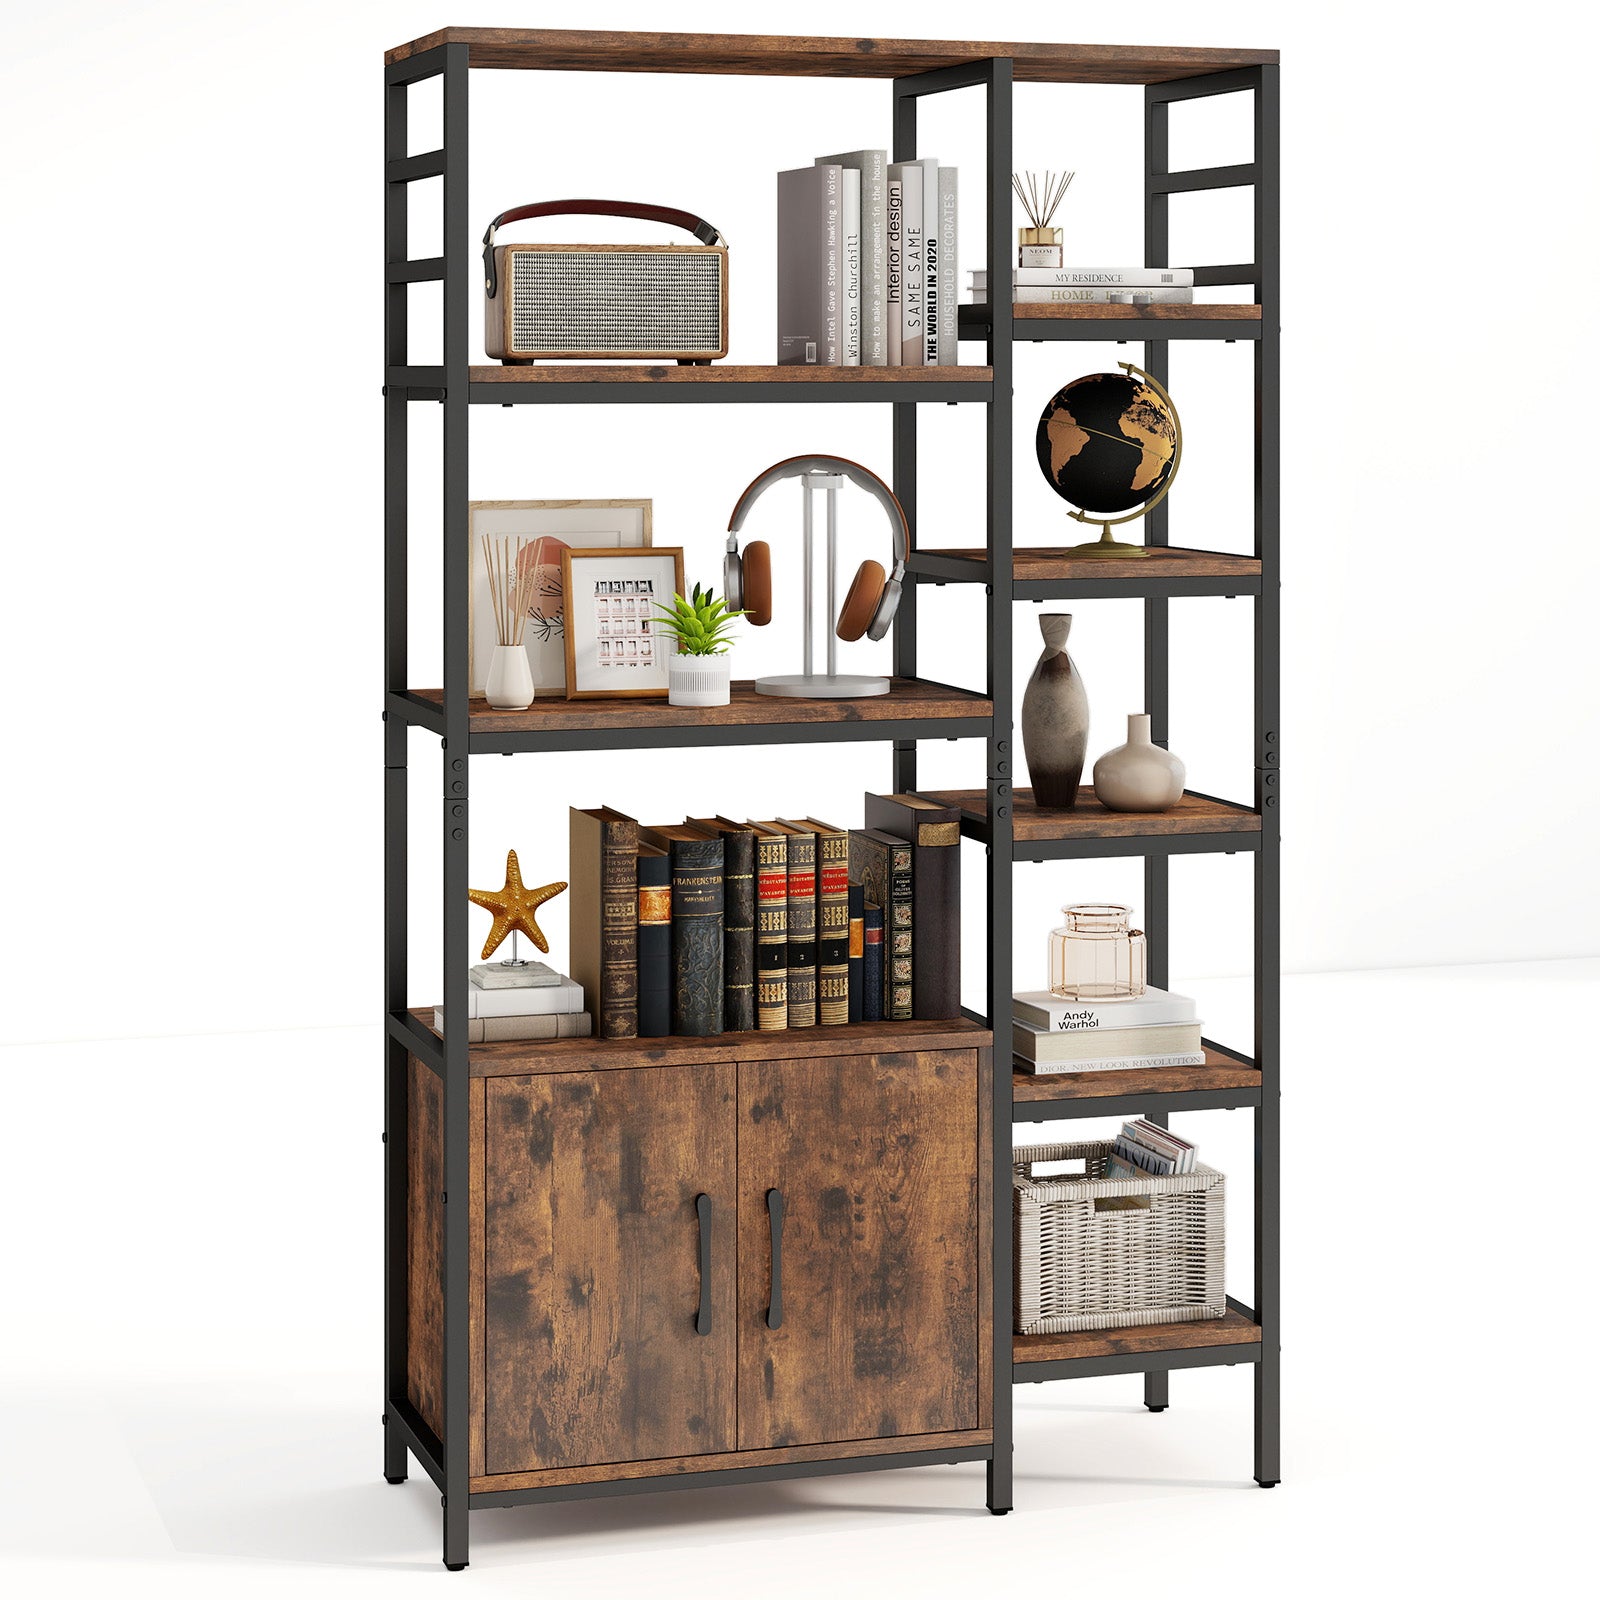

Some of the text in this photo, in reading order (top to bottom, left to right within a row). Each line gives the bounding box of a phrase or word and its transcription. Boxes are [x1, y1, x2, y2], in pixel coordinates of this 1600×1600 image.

[828, 169, 836, 195] Voice
[828, 210, 838, 246] Hawking
[872, 154, 883, 358] How to make an arrangement in the house
[887, 187, 902, 304] Interior design
[828, 250, 838, 286] Stephen
[908, 227, 921, 327] SAME SAME
[944, 193, 955, 336] HOUSEHOLD DECORATES
[1055, 273, 1124, 282] MY RESIDENCE
[828, 291, 836, 312] Gave
[848, 233, 858, 358] Winston Churchill
[927, 238, 937, 361] THE WORLD IN 2020
[1051, 290, 1094, 300] HOME
[828, 317, 836, 341] Intel
[828, 346, 836, 362] How
[673, 875, 722, 886] FRANKENSTEIN
[1058, 1018, 1099, 1030] Warhol
[1063, 1010, 1094, 1021] Andy
[1072, 1063, 1097, 1071] NEW
[1099, 1061, 1129, 1069] LOOK
[1132, 1056, 1201, 1067] REVOLUTION
